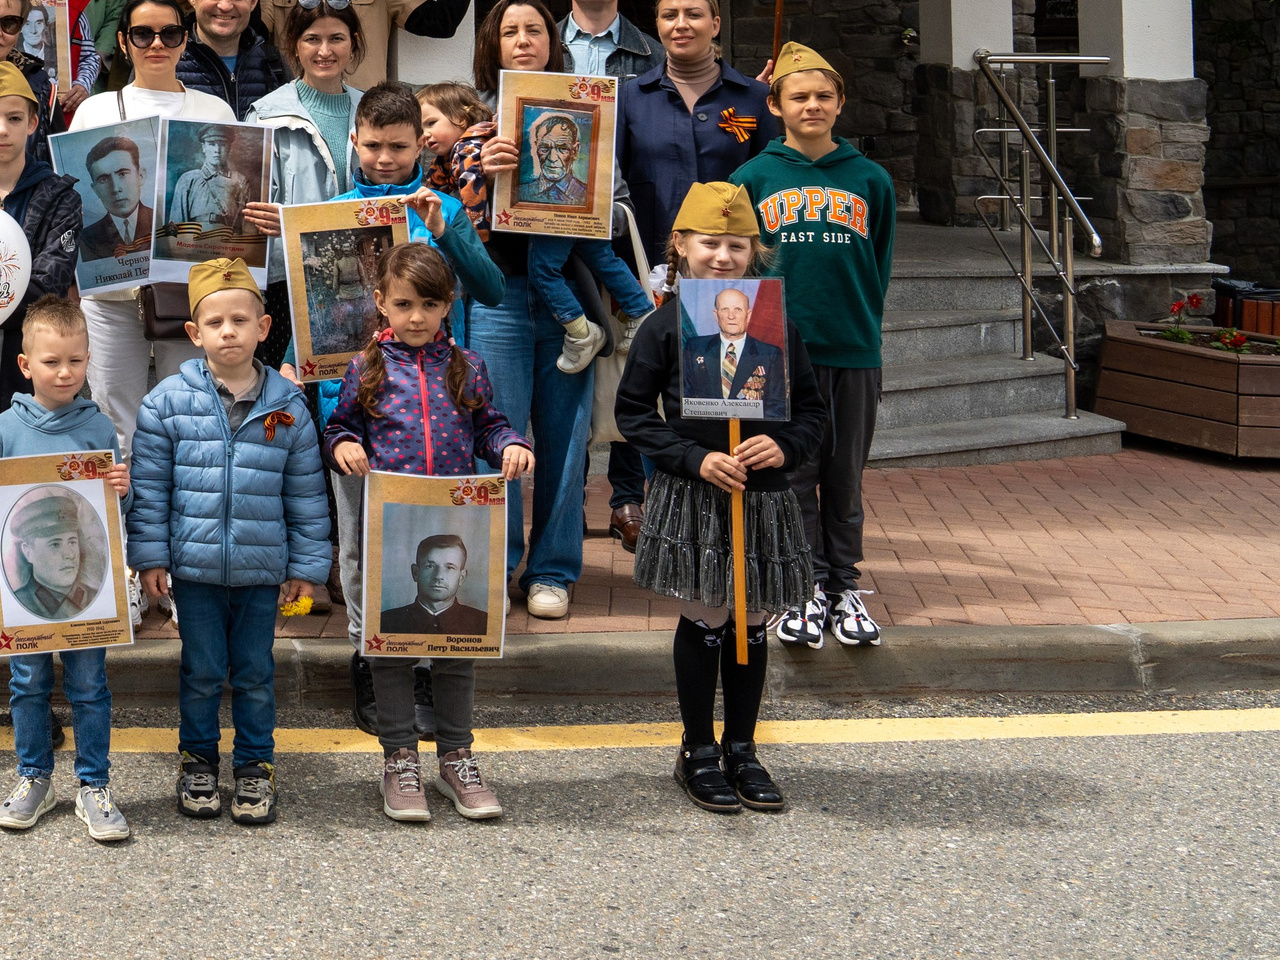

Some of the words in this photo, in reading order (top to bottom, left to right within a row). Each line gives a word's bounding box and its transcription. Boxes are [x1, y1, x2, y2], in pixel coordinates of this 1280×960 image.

[590, 84, 601, 101] 9
[379, 206, 390, 225] 9
[758, 186, 869, 240] UPPER
[780, 232, 815, 243] EAST
[822, 232, 851, 244] SIDE
[94, 269, 133, 285] Николай
[684, 399, 719, 407] Яковенко
[720, 400, 760, 408] Александр
[684, 408, 728, 416] Степанович
[84, 460, 98, 479] 9
[476, 486, 489, 506] 9
[446, 636, 482, 644] Воронов
[427, 644, 448, 653] Петр
[450, 644, 500, 653] Васильевич
